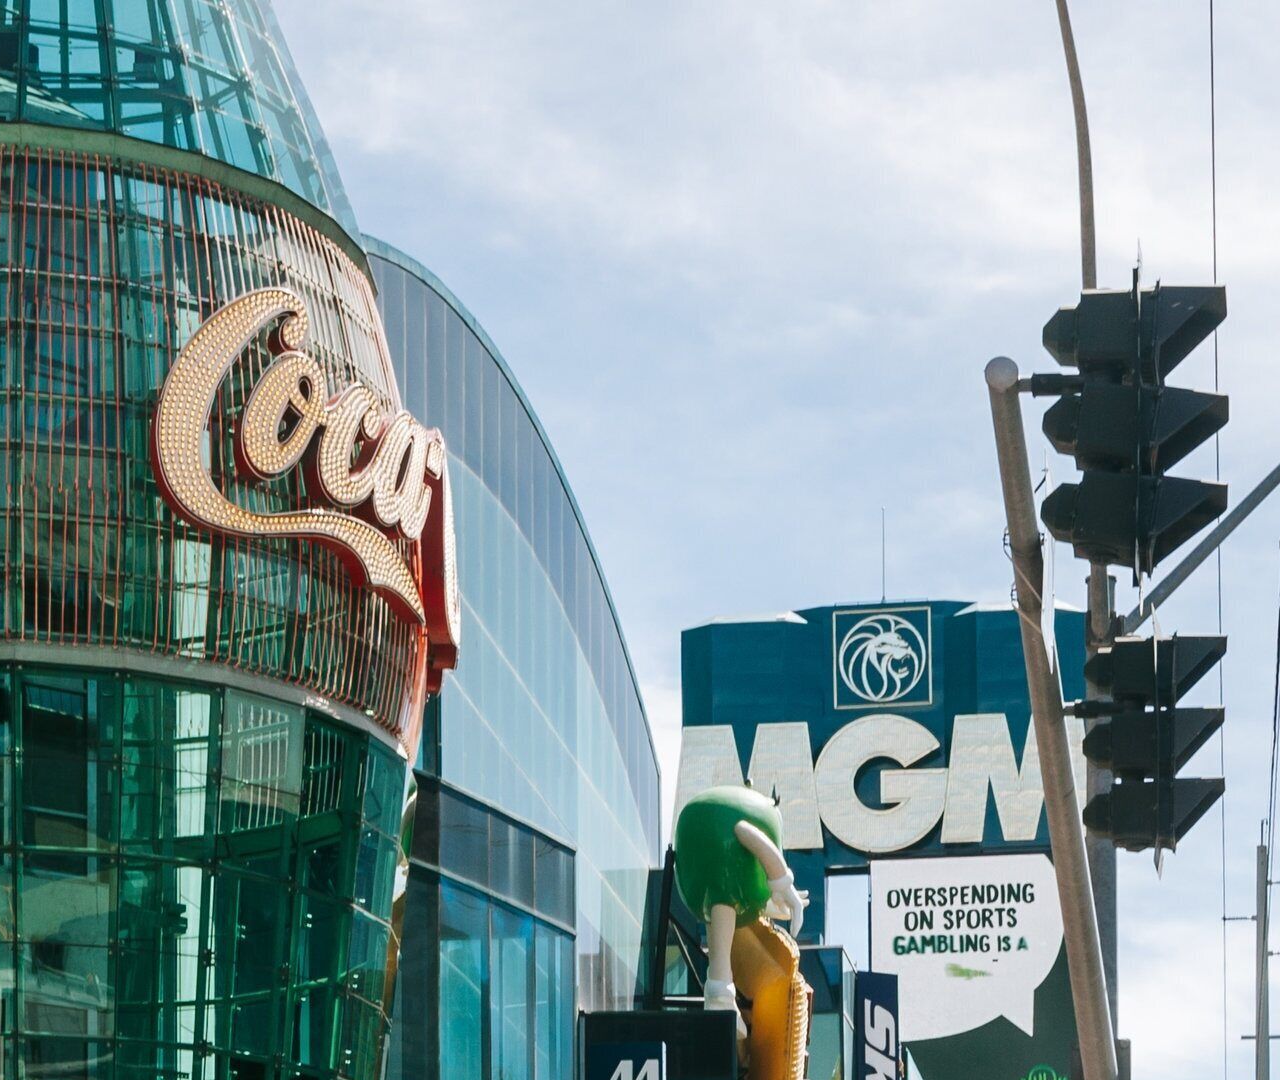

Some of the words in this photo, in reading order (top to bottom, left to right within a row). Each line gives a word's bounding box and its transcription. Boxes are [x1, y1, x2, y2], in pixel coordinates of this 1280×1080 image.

[671, 713, 1087, 853] MGM
[886, 883, 1035, 909] OVERSPENDING
[903, 911, 934, 931] ON
[943, 907, 1018, 930] SPORTS
[892, 934, 990, 955] GAMBLING
[997, 935, 1011, 951] IS
[1016, 936, 1029, 951] A
